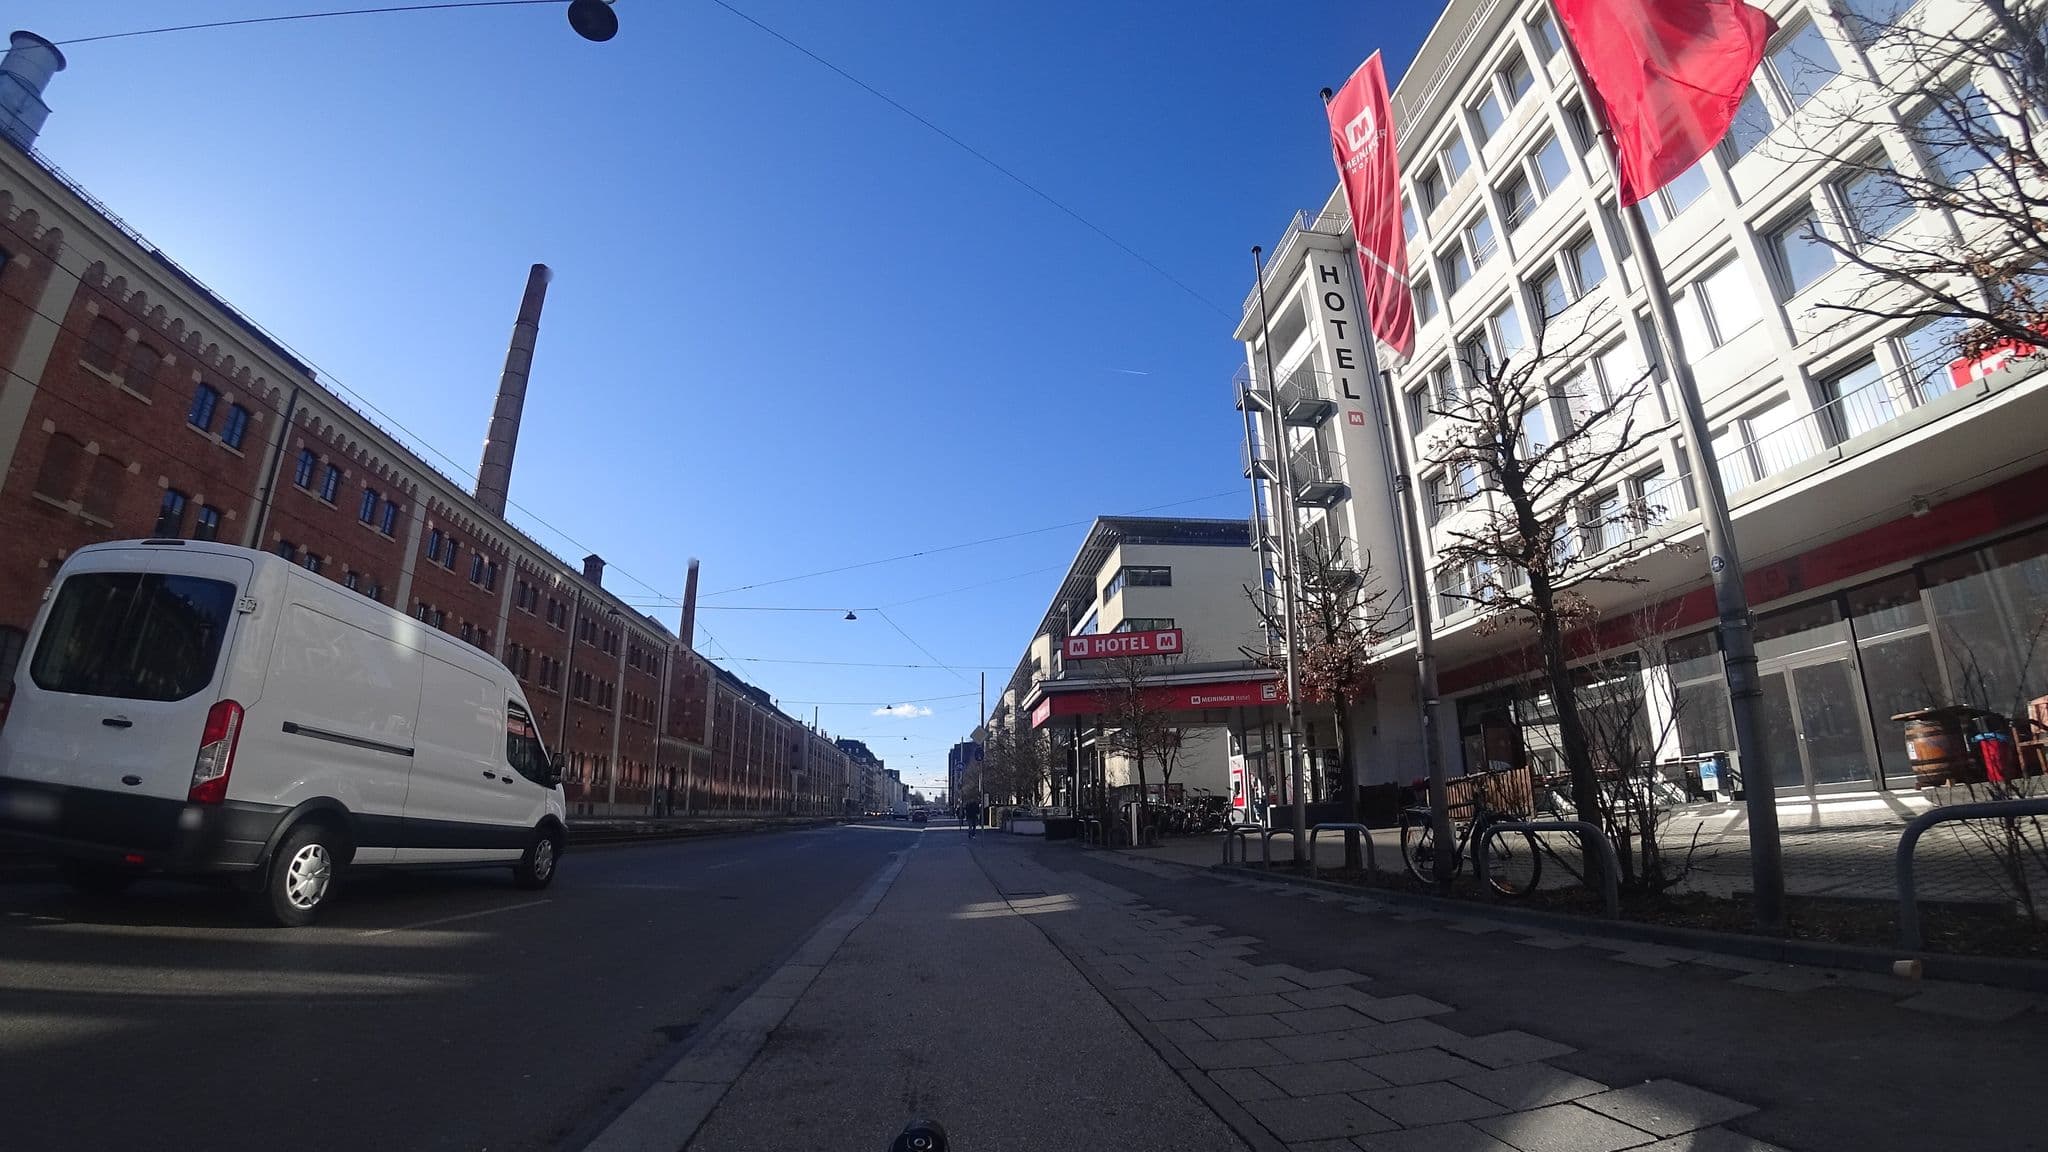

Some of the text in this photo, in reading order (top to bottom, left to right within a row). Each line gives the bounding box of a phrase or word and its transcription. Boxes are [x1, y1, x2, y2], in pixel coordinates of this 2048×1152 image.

[1319, 264, 1360, 400] HOTEL
[1095, 636, 1150, 653] HOTEL
[1201, 695, 1235, 703] MEININGER
